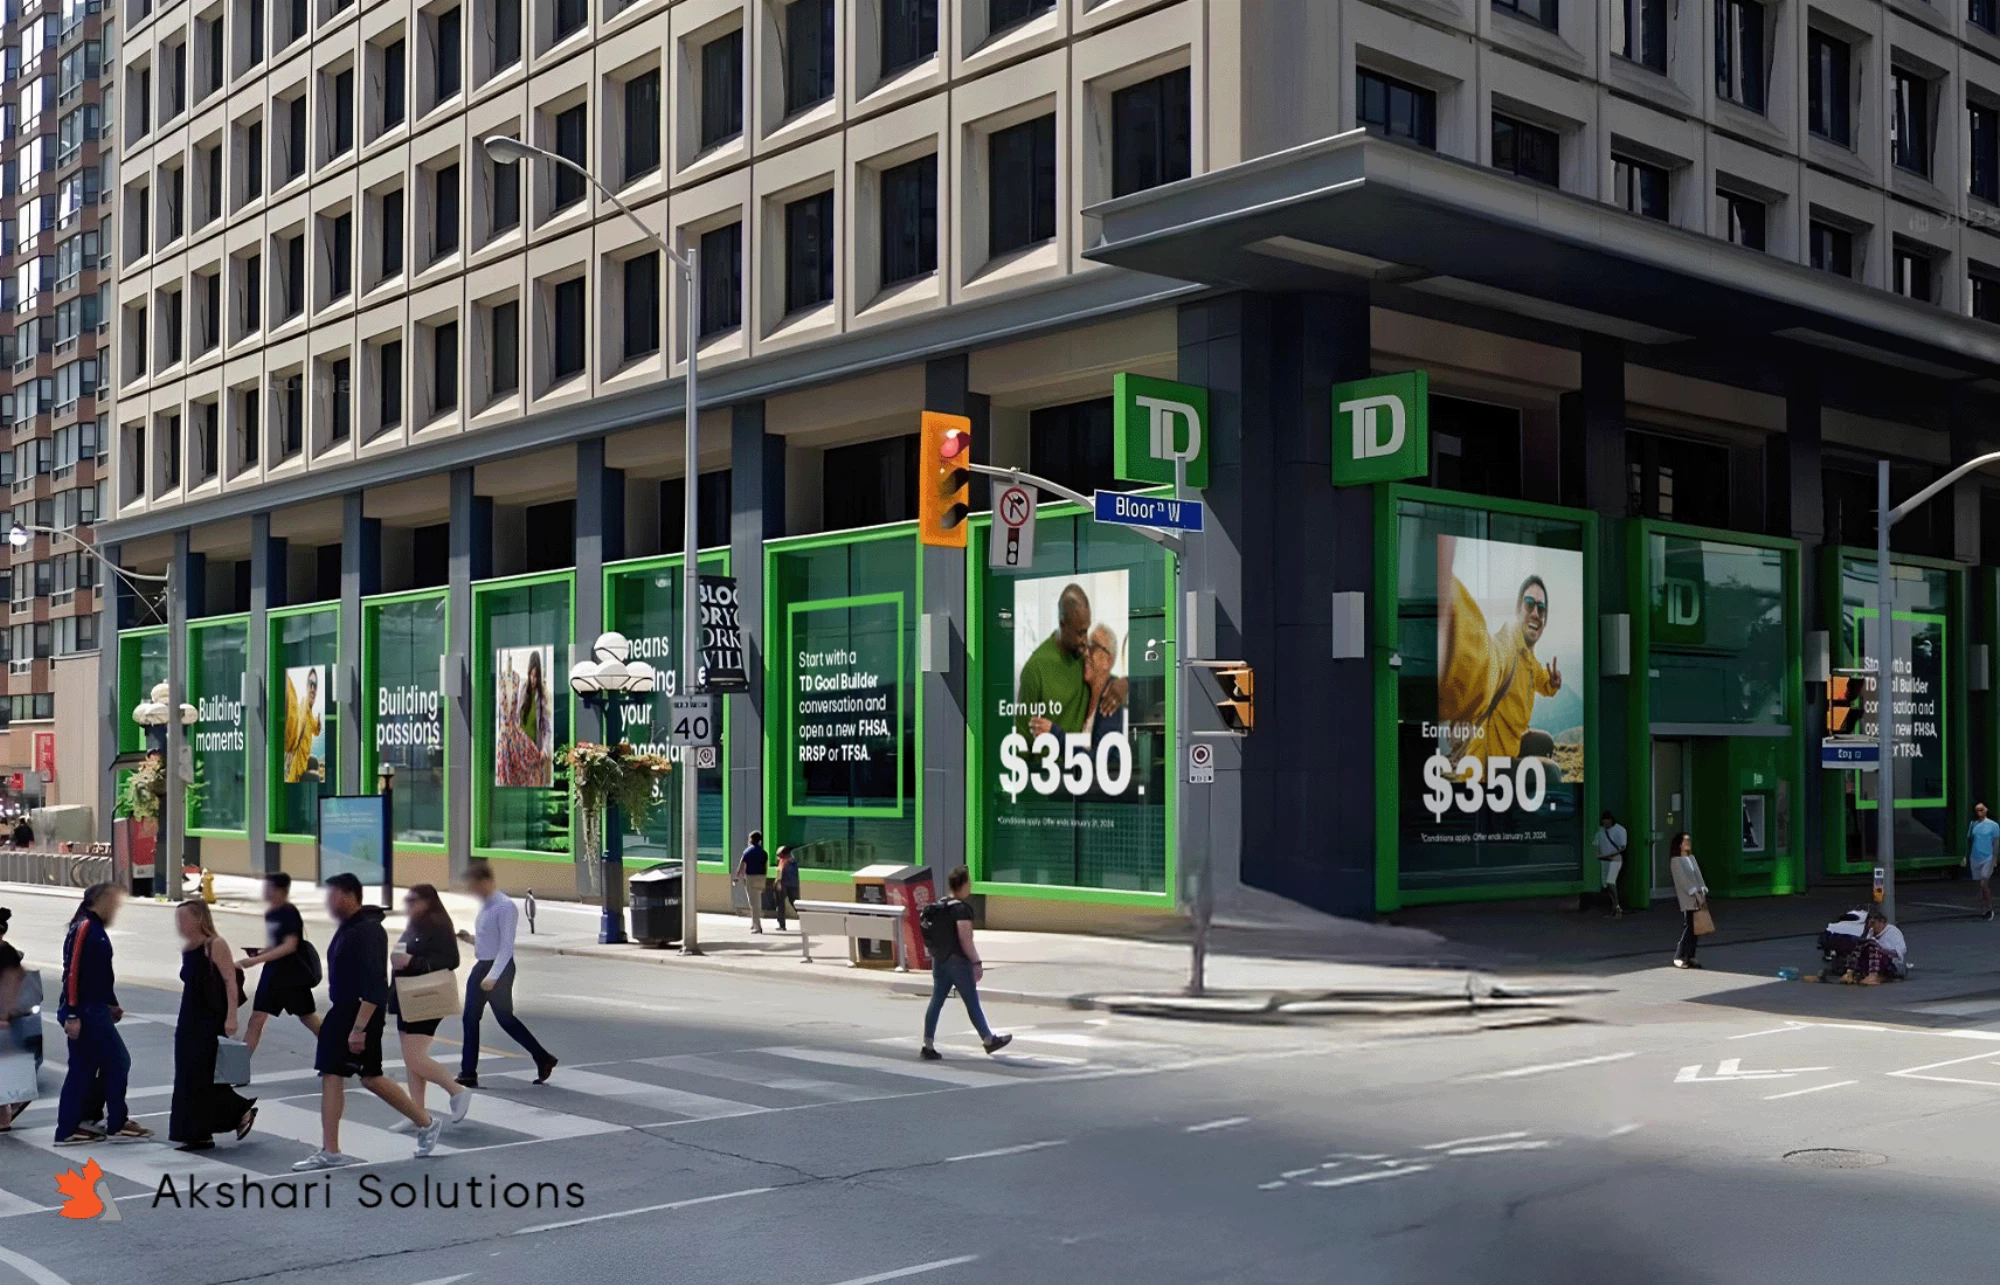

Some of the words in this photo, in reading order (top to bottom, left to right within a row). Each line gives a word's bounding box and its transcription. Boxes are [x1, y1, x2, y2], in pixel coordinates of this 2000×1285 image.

[1136, 395, 1200, 462] TD
[1339, 394, 1405, 459] TD
[1116, 496, 1154, 519] Bloor
[1168, 502, 1180, 522] W
[799, 651, 824, 668] Start
[825, 649, 847, 666] with
[849, 651, 857, 664] a
[1864, 657, 1879, 671] Sta
[1892, 657, 1904, 673] th
[1905, 662, 1912, 674] a
[799, 675, 813, 692] TD
[815, 673, 839, 690] Goal
[841, 672, 878, 690] Builder
[1865, 677, 1877, 691] TD
[1900, 678, 1929, 693] Builder
[199, 694, 240, 726] Building
[379, 685, 438, 720] Building
[799, 695, 863, 713] conversation
[865, 694, 886, 711] and
[998, 699, 1027, 716] Earn
[1030, 702, 1046, 718] up
[1049, 699, 1062, 716] to
[1918, 700, 1934, 715] and
[620, 703, 652, 732] your
[376, 715, 440, 752] passions
[674, 717, 709, 740] 40
[799, 724, 824, 741] open
[826, 724, 832, 737] a
[835, 723, 856, 737] new
[859, 719, 891, 744] FHSA,
[1422, 721, 1451, 738] Earn
[1453, 725, 1470, 741] up
[1473, 725, 1485, 739] to
[1865, 723, 1879, 736] op
[1896, 723, 1912, 736] new
[1914, 722, 1937, 738] FHSA,
[196, 728, 243, 751] moments
[620, 736, 684, 762] nancial
[1900, 743, 1923, 757] TFSA.
[799, 745, 826, 761] RRSP
[828, 748, 839, 761] or
[841, 744, 871, 761] TFSA.
[1423, 748, 1556, 823] $350.
[1472, 832, 1487, 841] Offer
[1502, 832, 1523, 841] January
